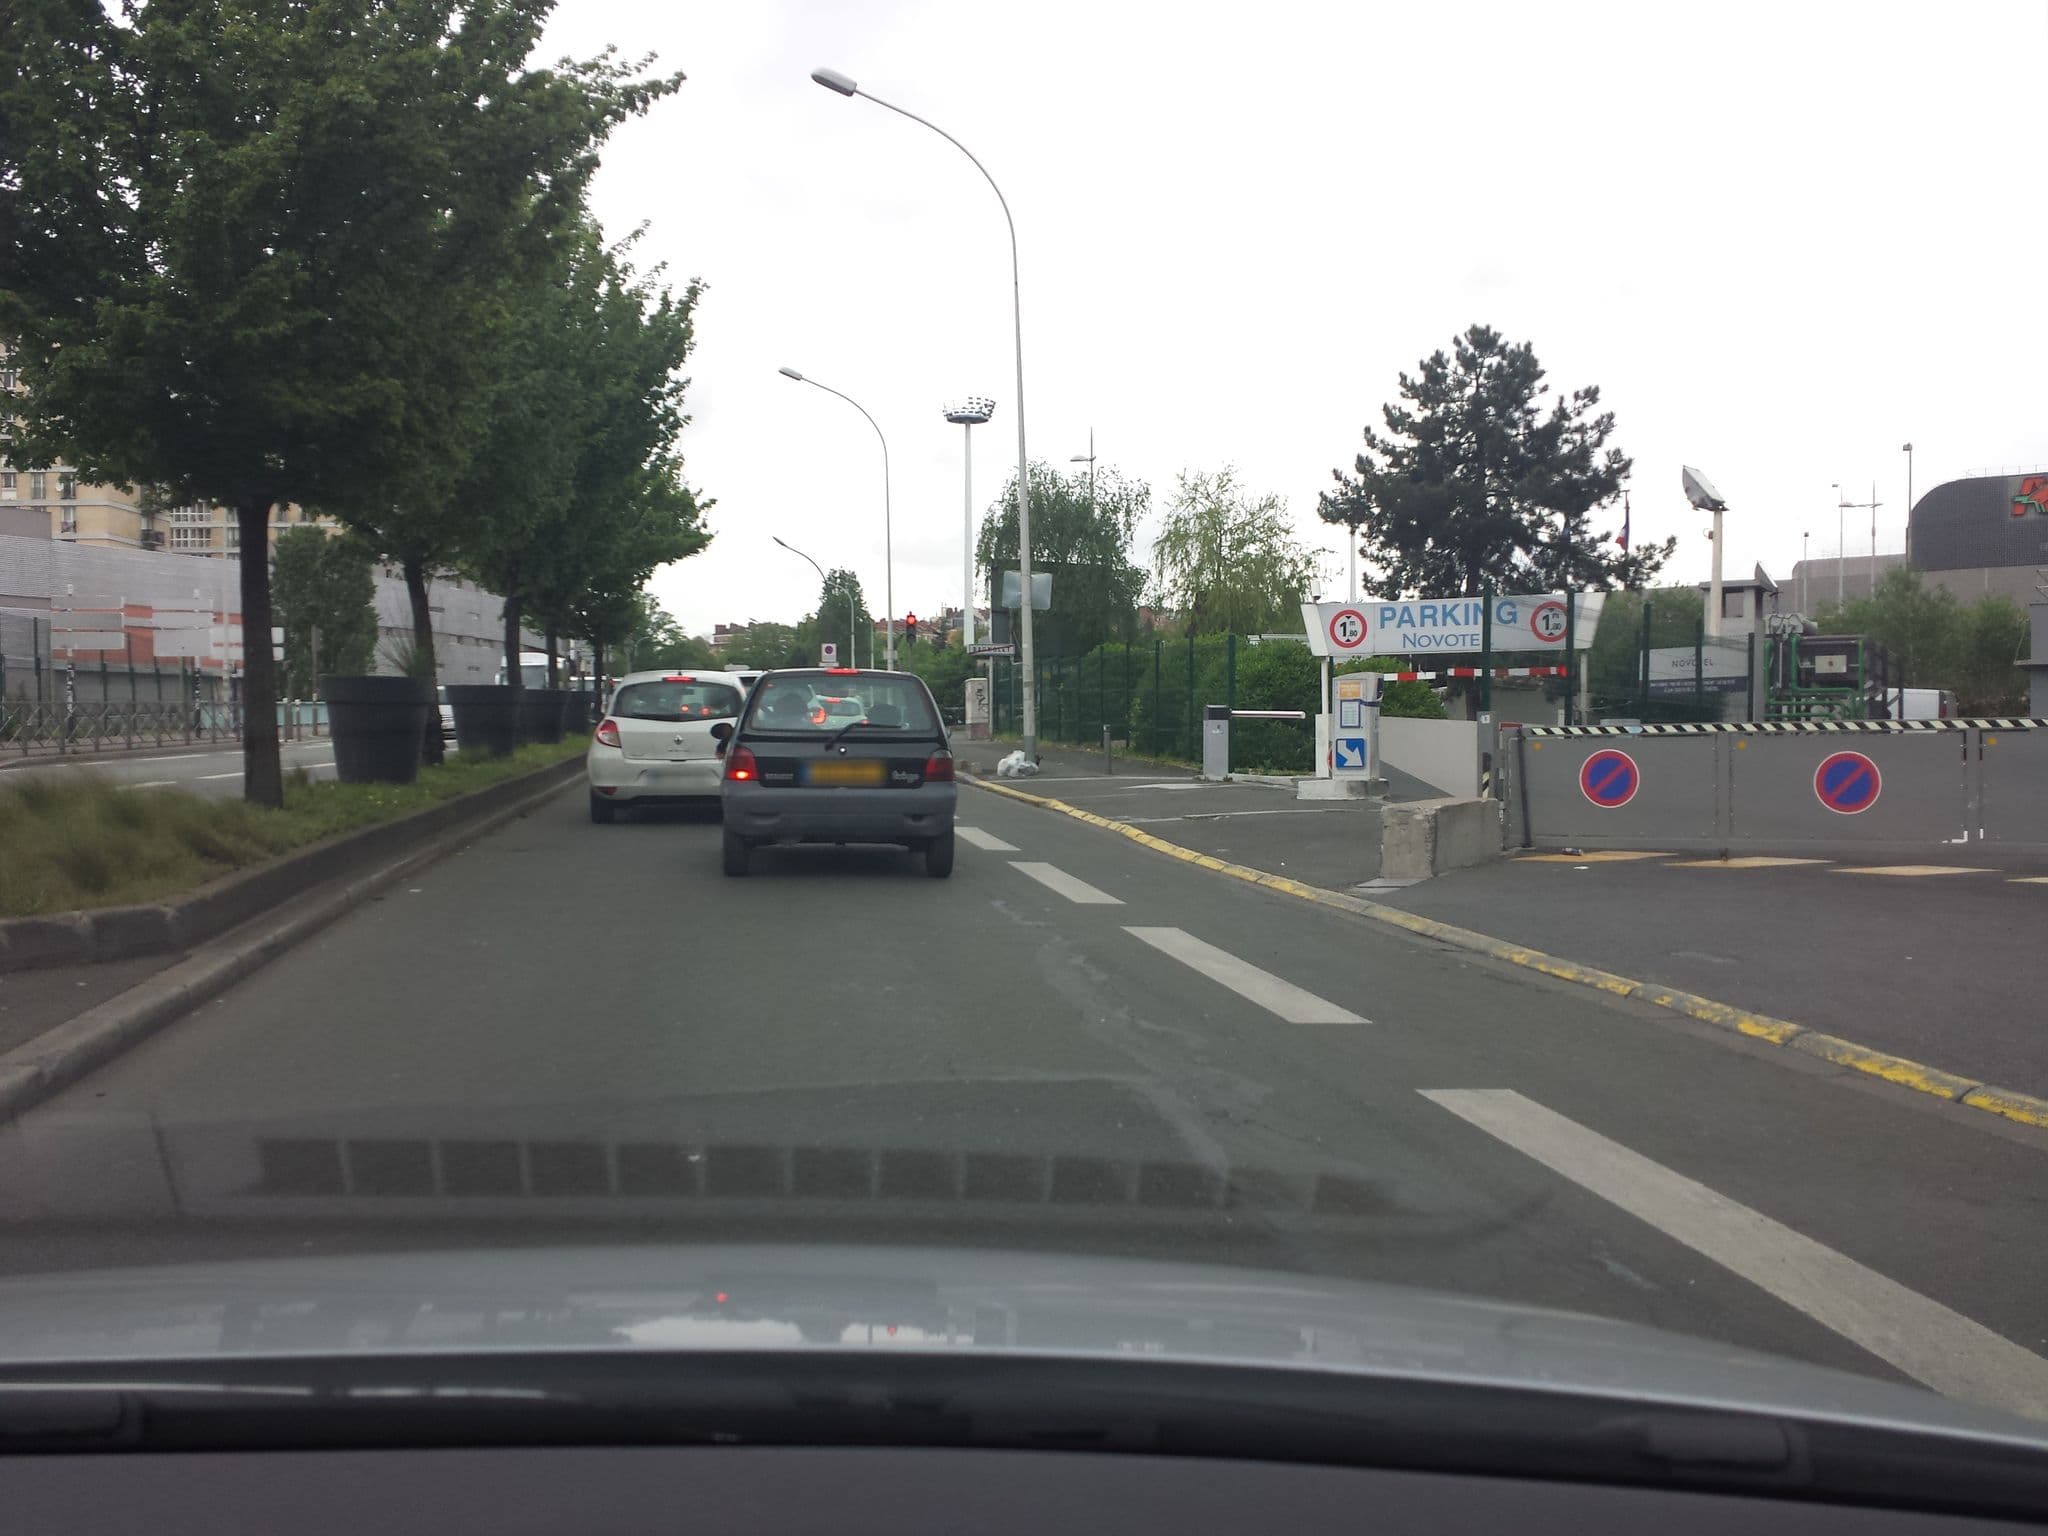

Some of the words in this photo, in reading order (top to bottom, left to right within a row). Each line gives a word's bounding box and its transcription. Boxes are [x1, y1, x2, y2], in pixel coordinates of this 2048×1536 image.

[1379, 600, 1518, 629] PARKING
[1402, 633, 1494, 648] NOVOTE
[1671, 658, 1713, 667] NOVOEL
